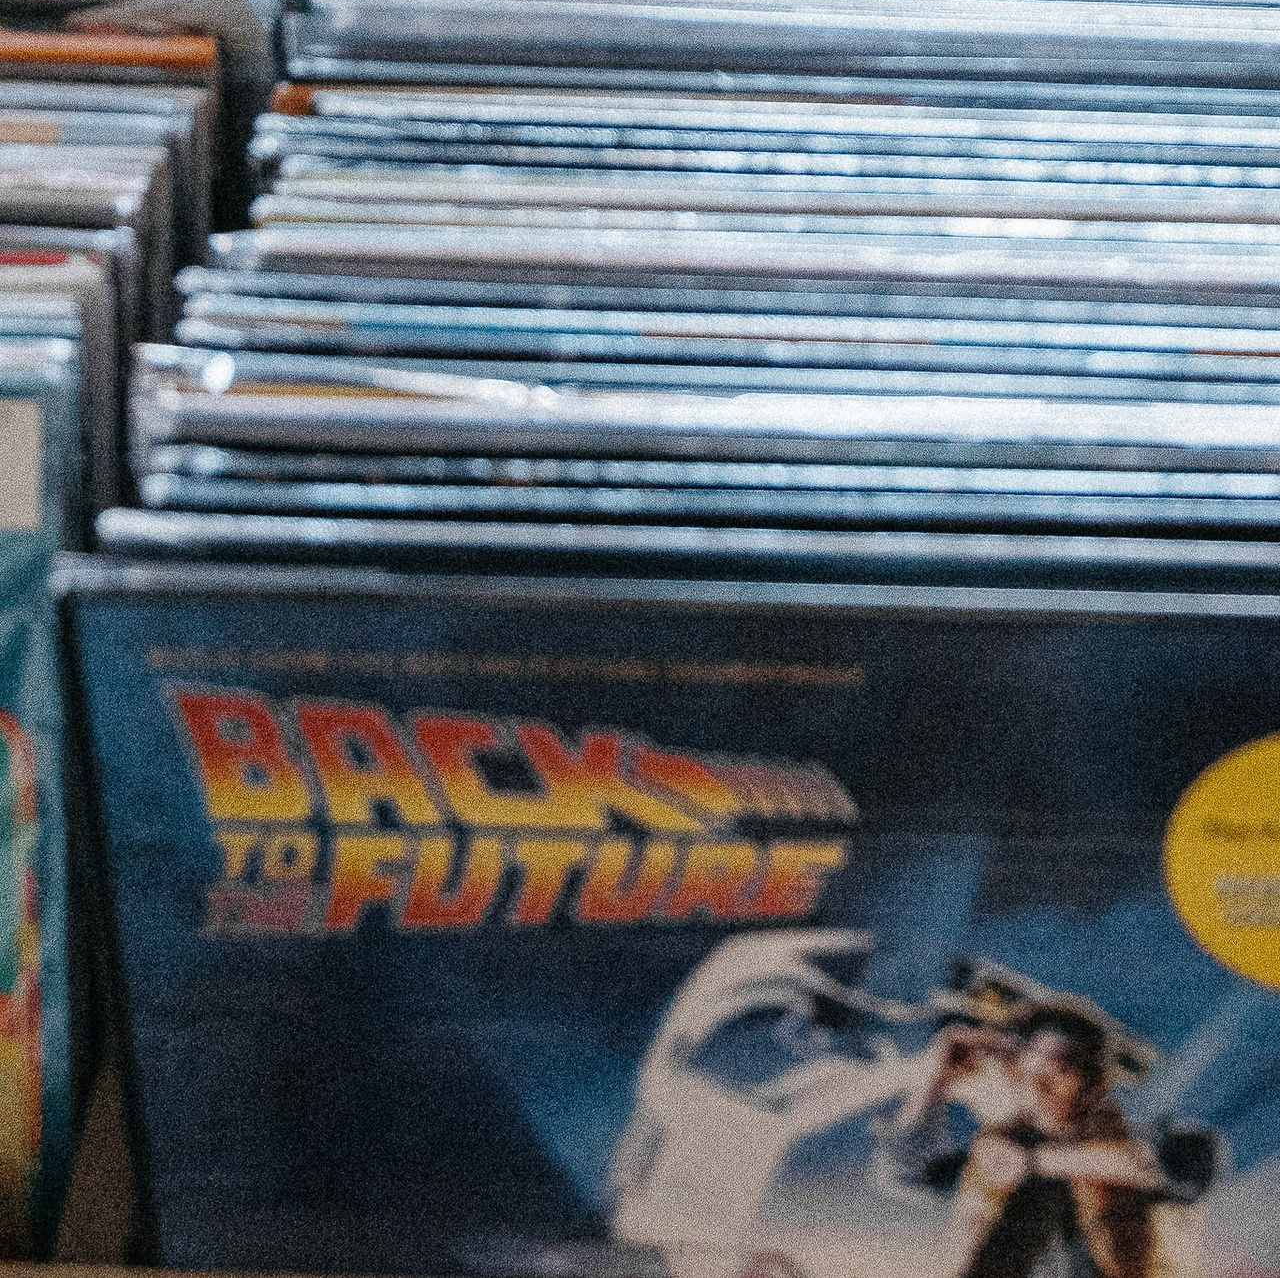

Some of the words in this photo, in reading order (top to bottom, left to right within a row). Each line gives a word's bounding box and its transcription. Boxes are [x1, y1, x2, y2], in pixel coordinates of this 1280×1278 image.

[163, 681, 731, 835] BACK
[212, 830, 318, 882] TO
[320, 833, 852, 934] FUTURE
